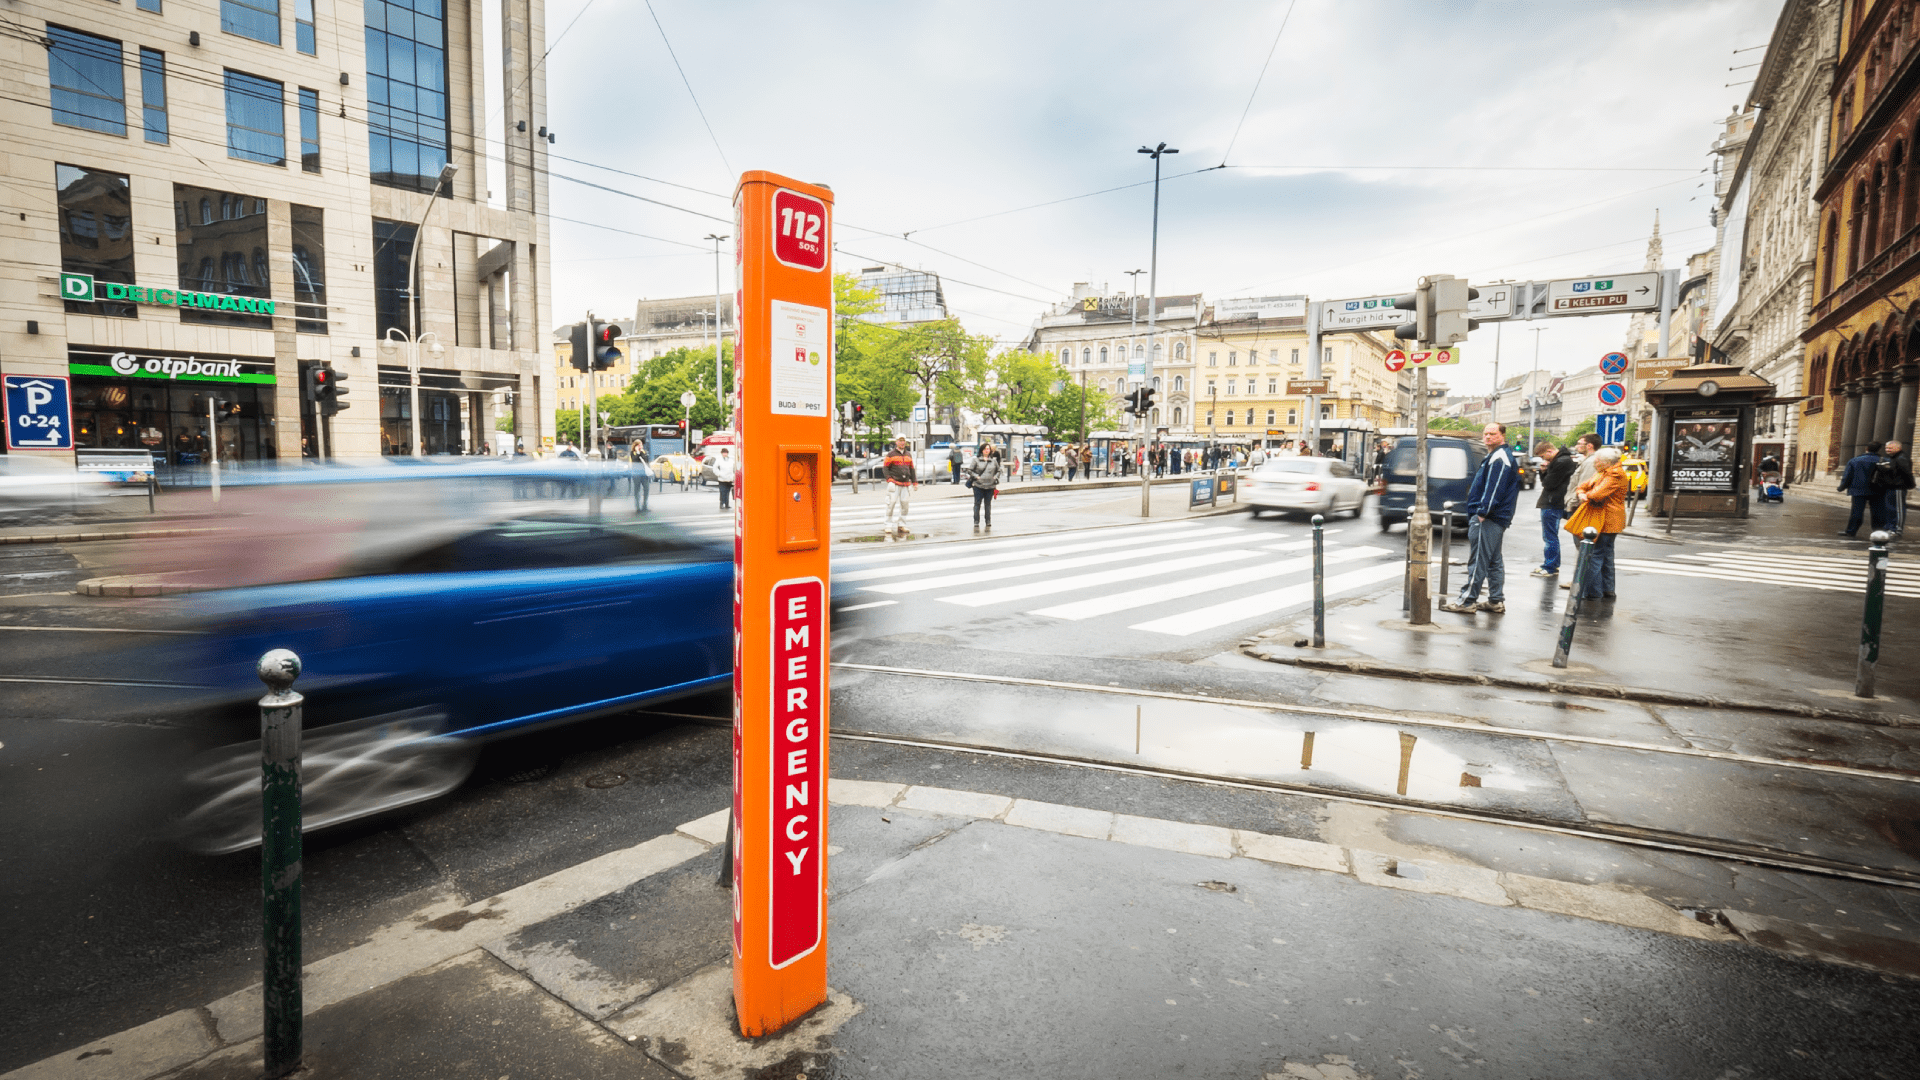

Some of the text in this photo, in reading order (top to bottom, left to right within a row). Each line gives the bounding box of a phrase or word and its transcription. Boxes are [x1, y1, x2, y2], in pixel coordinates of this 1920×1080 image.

[782, 207, 821, 244] 112
[1574, 282, 1589, 292] M3
[66, 277, 275, 315] D DEICHMANN
[1572, 296, 1625, 307] KELETI PU.
[1346, 302, 1359, 310] M2
[1338, 314, 1367, 325] Margit
[145, 355, 242, 379] otpbank
[26, 386, 53, 415] P
[18, 414, 61, 428] 0-24
[1672, 470, 1733, 478] 2016.05.07.
[785, 595, 809, 877] EMERGENCY
